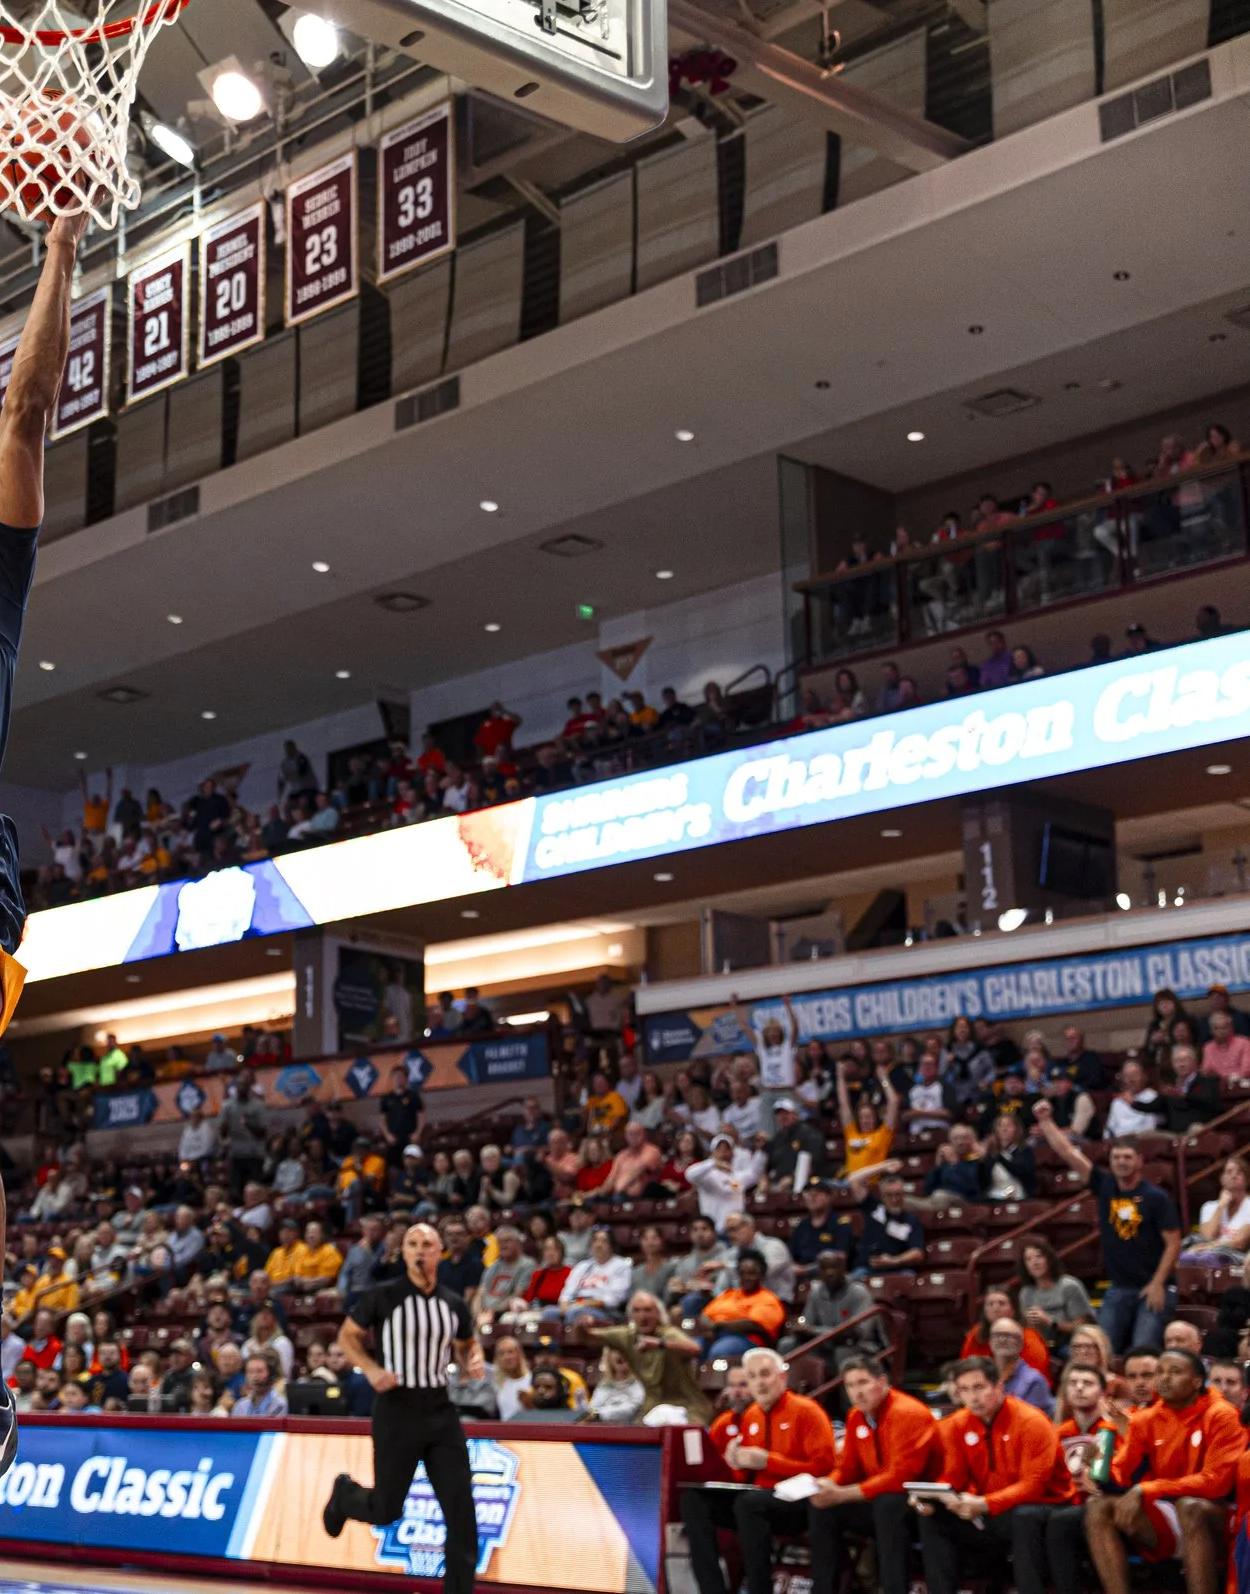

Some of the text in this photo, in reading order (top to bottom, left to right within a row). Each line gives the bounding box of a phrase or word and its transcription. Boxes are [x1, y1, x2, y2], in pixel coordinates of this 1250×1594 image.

[397, 175, 434, 229] 33
[305, 224, 338, 276] 23
[216, 270, 247, 320] 20
[144, 310, 170, 357] 21
[67, 349, 95, 393] 42
[723, 699, 1075, 823] Charleston
[855, 977, 983, 1031] CHILDREN'S
[983, 956, 1143, 1015] CHARLESTON
[69, 1455, 236, 1522] Classic
